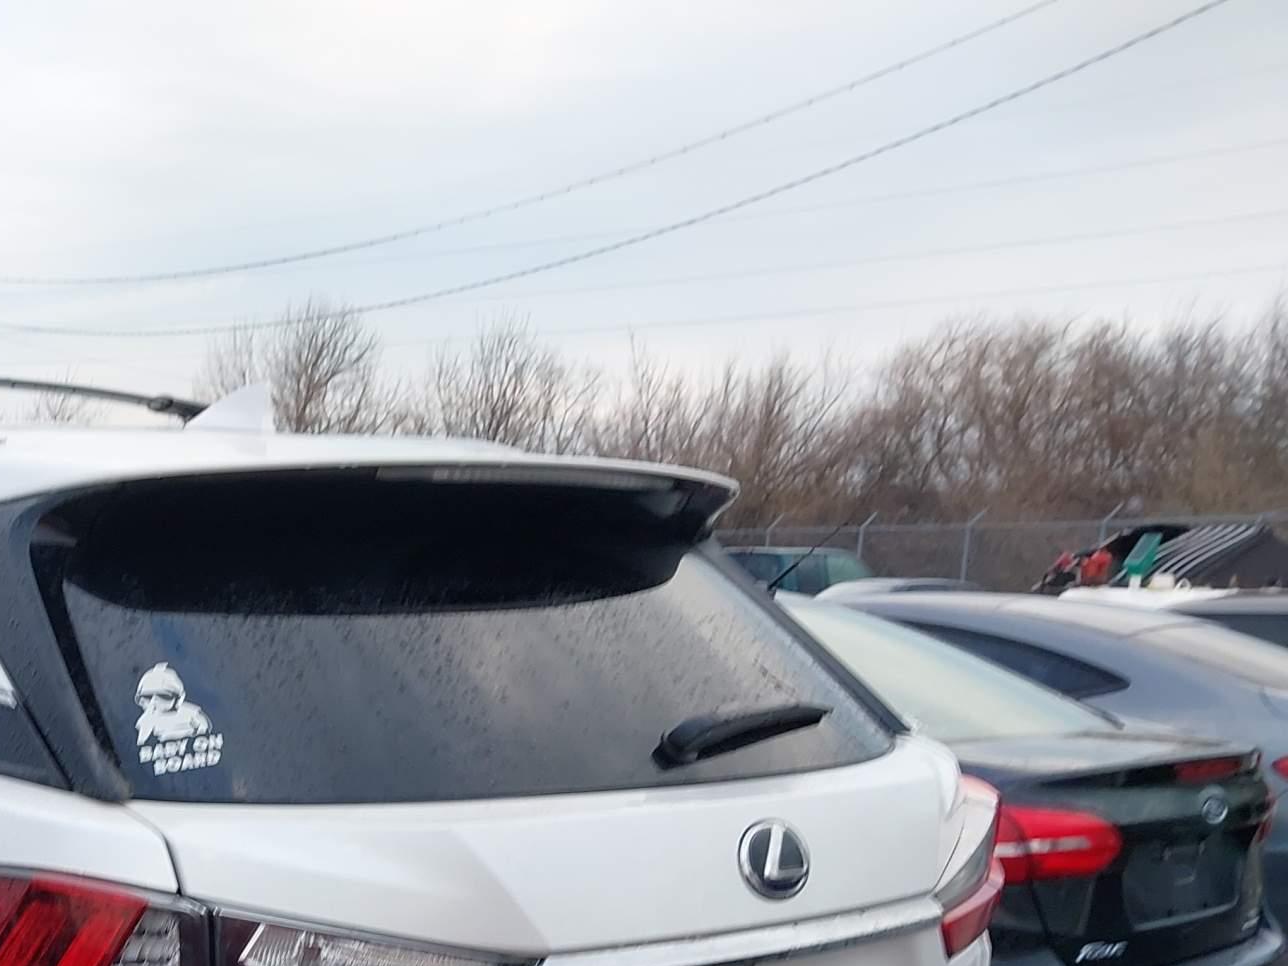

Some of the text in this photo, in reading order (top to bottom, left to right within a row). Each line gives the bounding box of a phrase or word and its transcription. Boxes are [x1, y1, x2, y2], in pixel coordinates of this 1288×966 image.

[139, 733, 224, 764] BABY ON
[153, 750, 222, 776] BOARD
